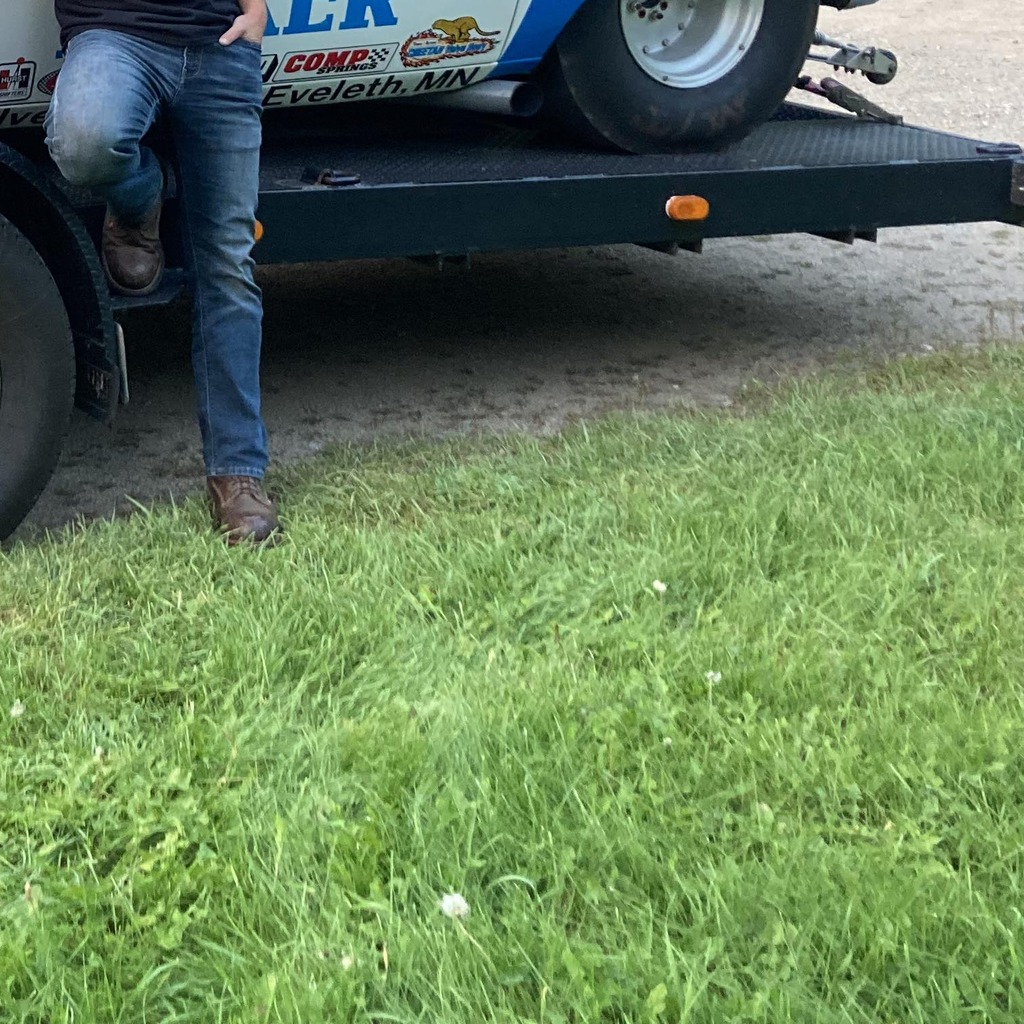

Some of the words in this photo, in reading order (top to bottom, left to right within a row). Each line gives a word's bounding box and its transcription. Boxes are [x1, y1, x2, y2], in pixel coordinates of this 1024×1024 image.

[283, 49, 369, 73] COMP
[316, 62, 378, 74] SPRINGS
[1, 75, 27, 83] HURST
[262, 74, 407, 106] Eveleth,
[414, 67, 481, 92] MN
